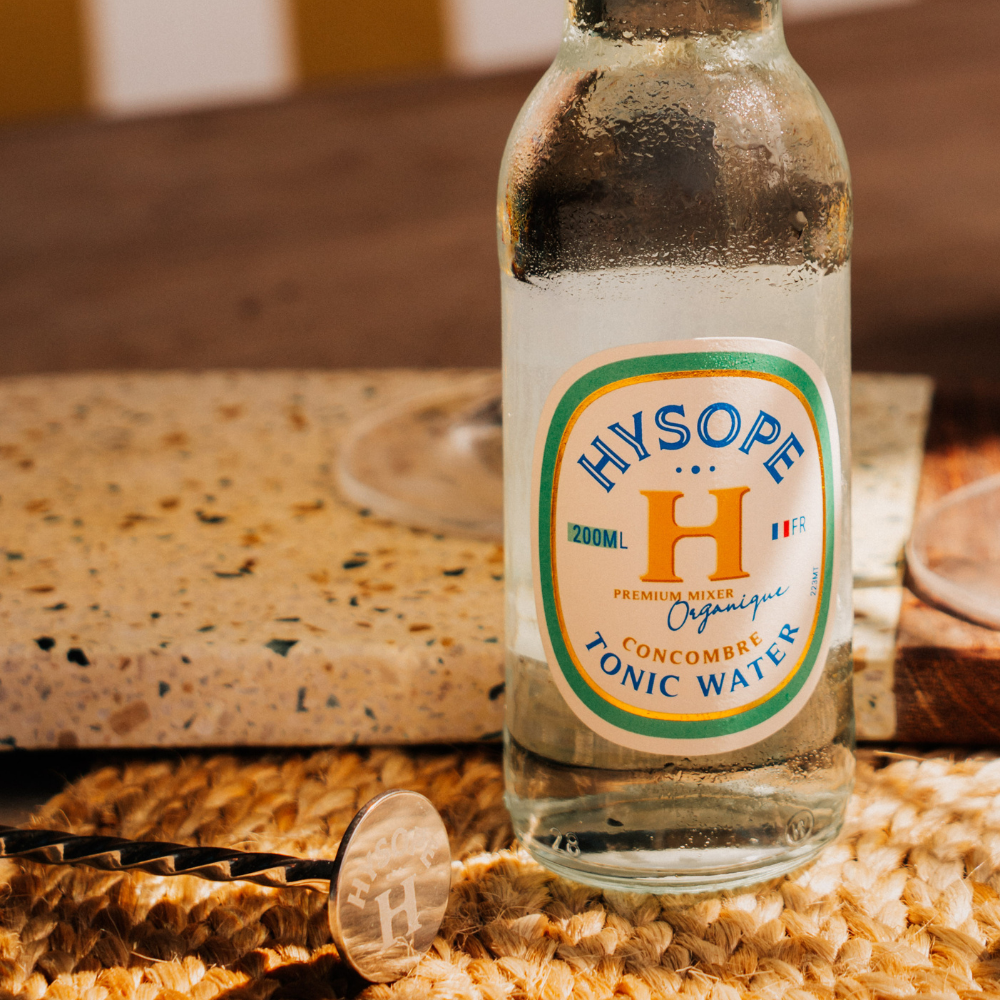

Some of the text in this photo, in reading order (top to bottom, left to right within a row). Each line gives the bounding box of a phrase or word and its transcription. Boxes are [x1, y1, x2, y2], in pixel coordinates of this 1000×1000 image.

[577, 402, 805, 493] HYSOPE
[572, 524, 628, 549] 200ML
[639, 486, 750, 583] H
[792, 516, 806, 535] FR
[613, 588, 735, 601] PREMIUM MIXER
[667, 585, 790, 634] Organique
[585, 623, 800, 698] TONIC WATER
[622, 631, 762, 665] CONCOMBRE
[375, 873, 422, 950] H
